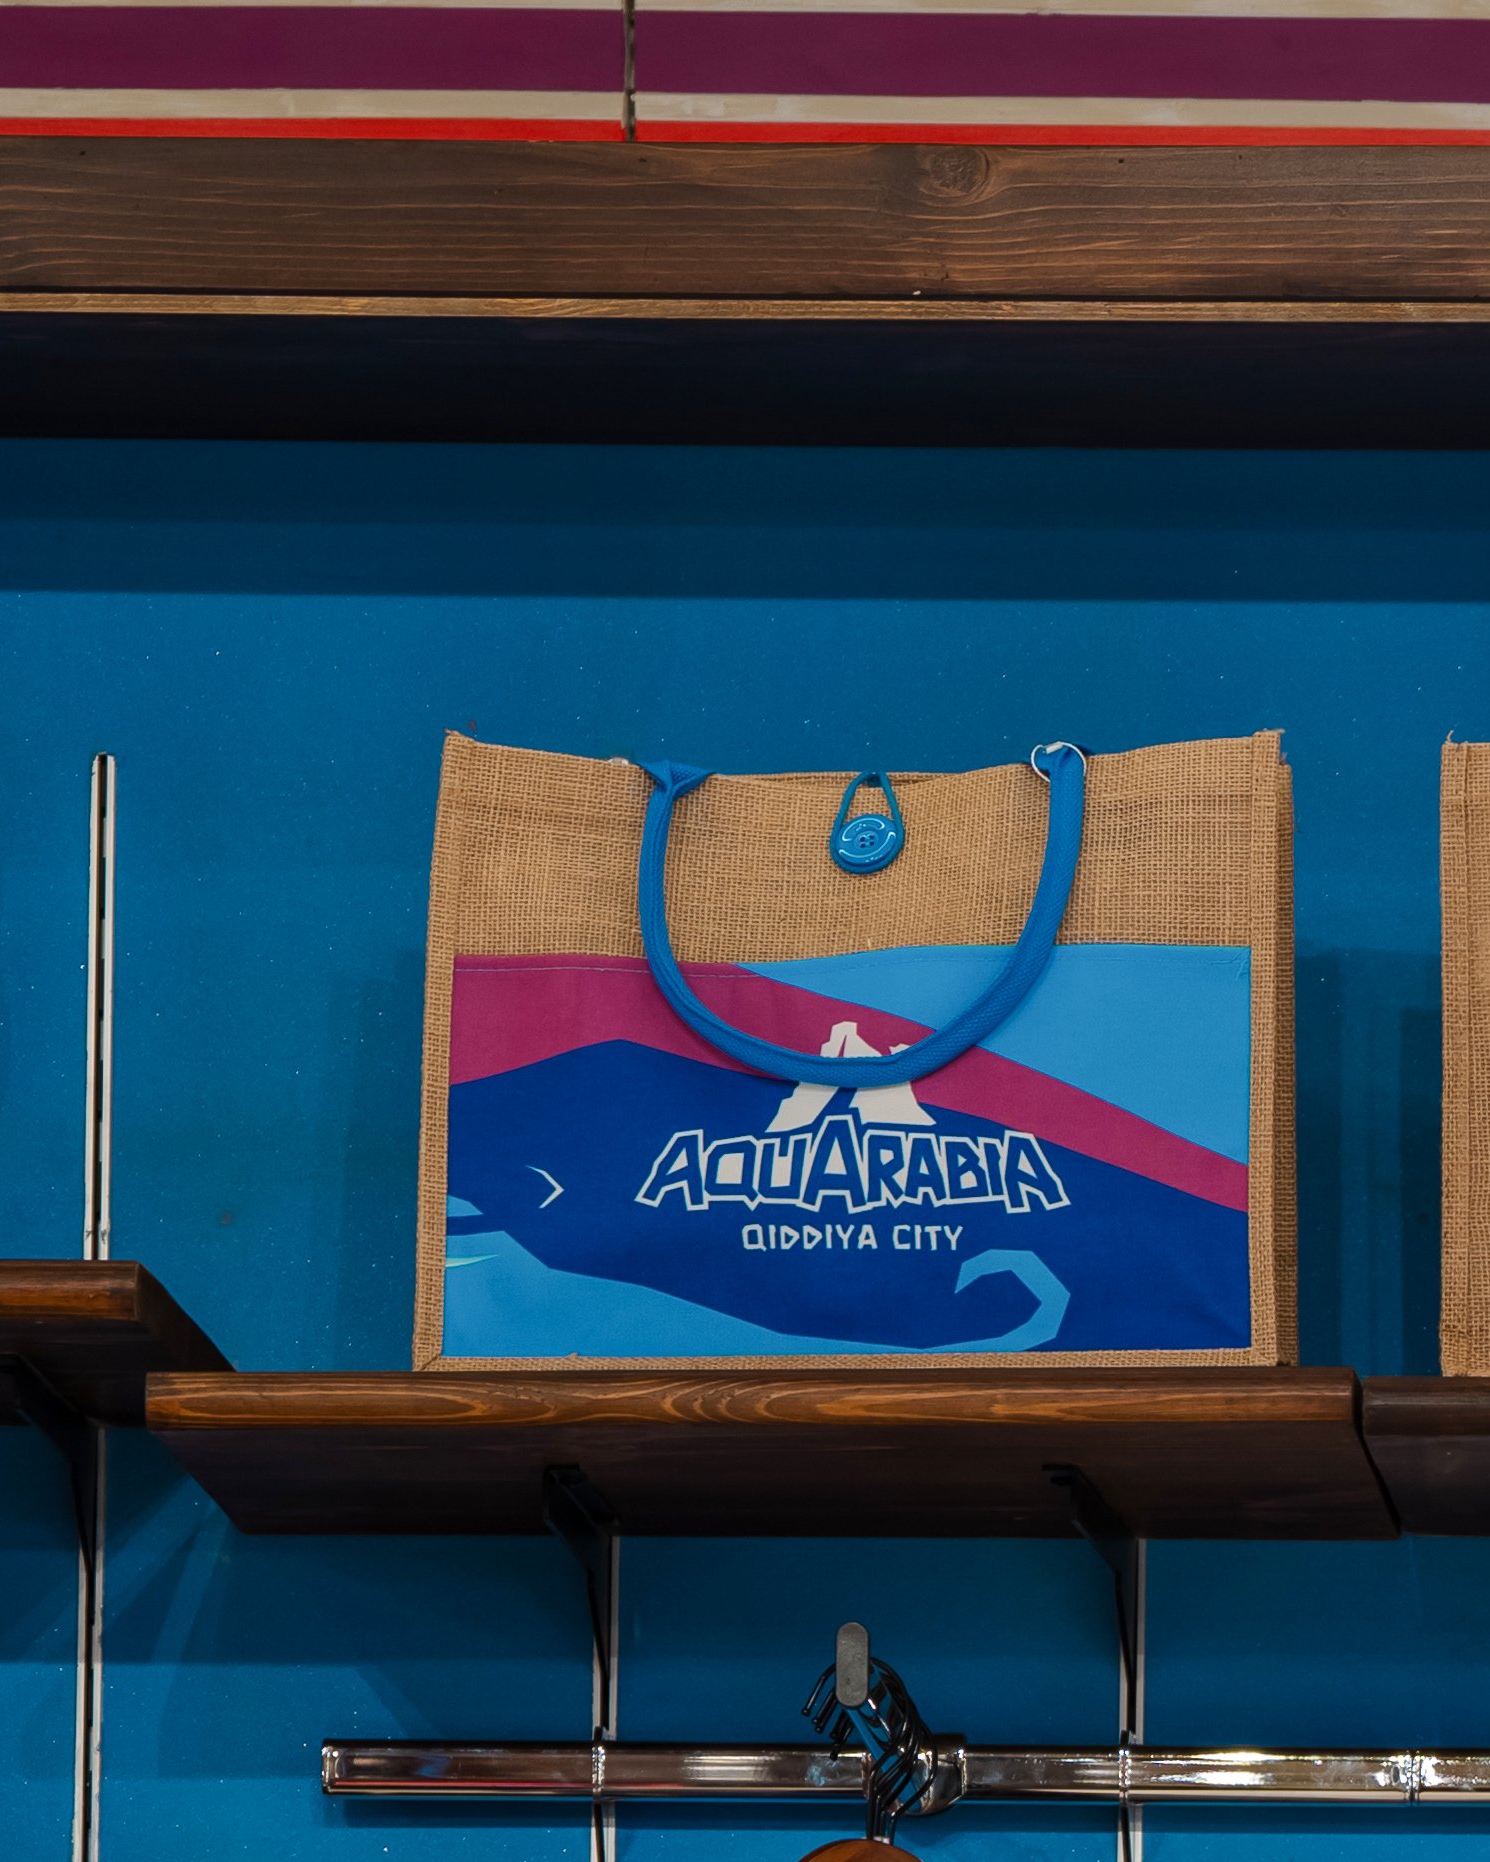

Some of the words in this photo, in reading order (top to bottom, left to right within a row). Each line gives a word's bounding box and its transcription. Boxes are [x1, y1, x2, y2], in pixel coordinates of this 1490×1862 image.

[635, 1115, 1071, 1214] AQUARABIA
[742, 1223, 878, 1251] QIDDIYA
[893, 1225, 963, 1251] CITY
